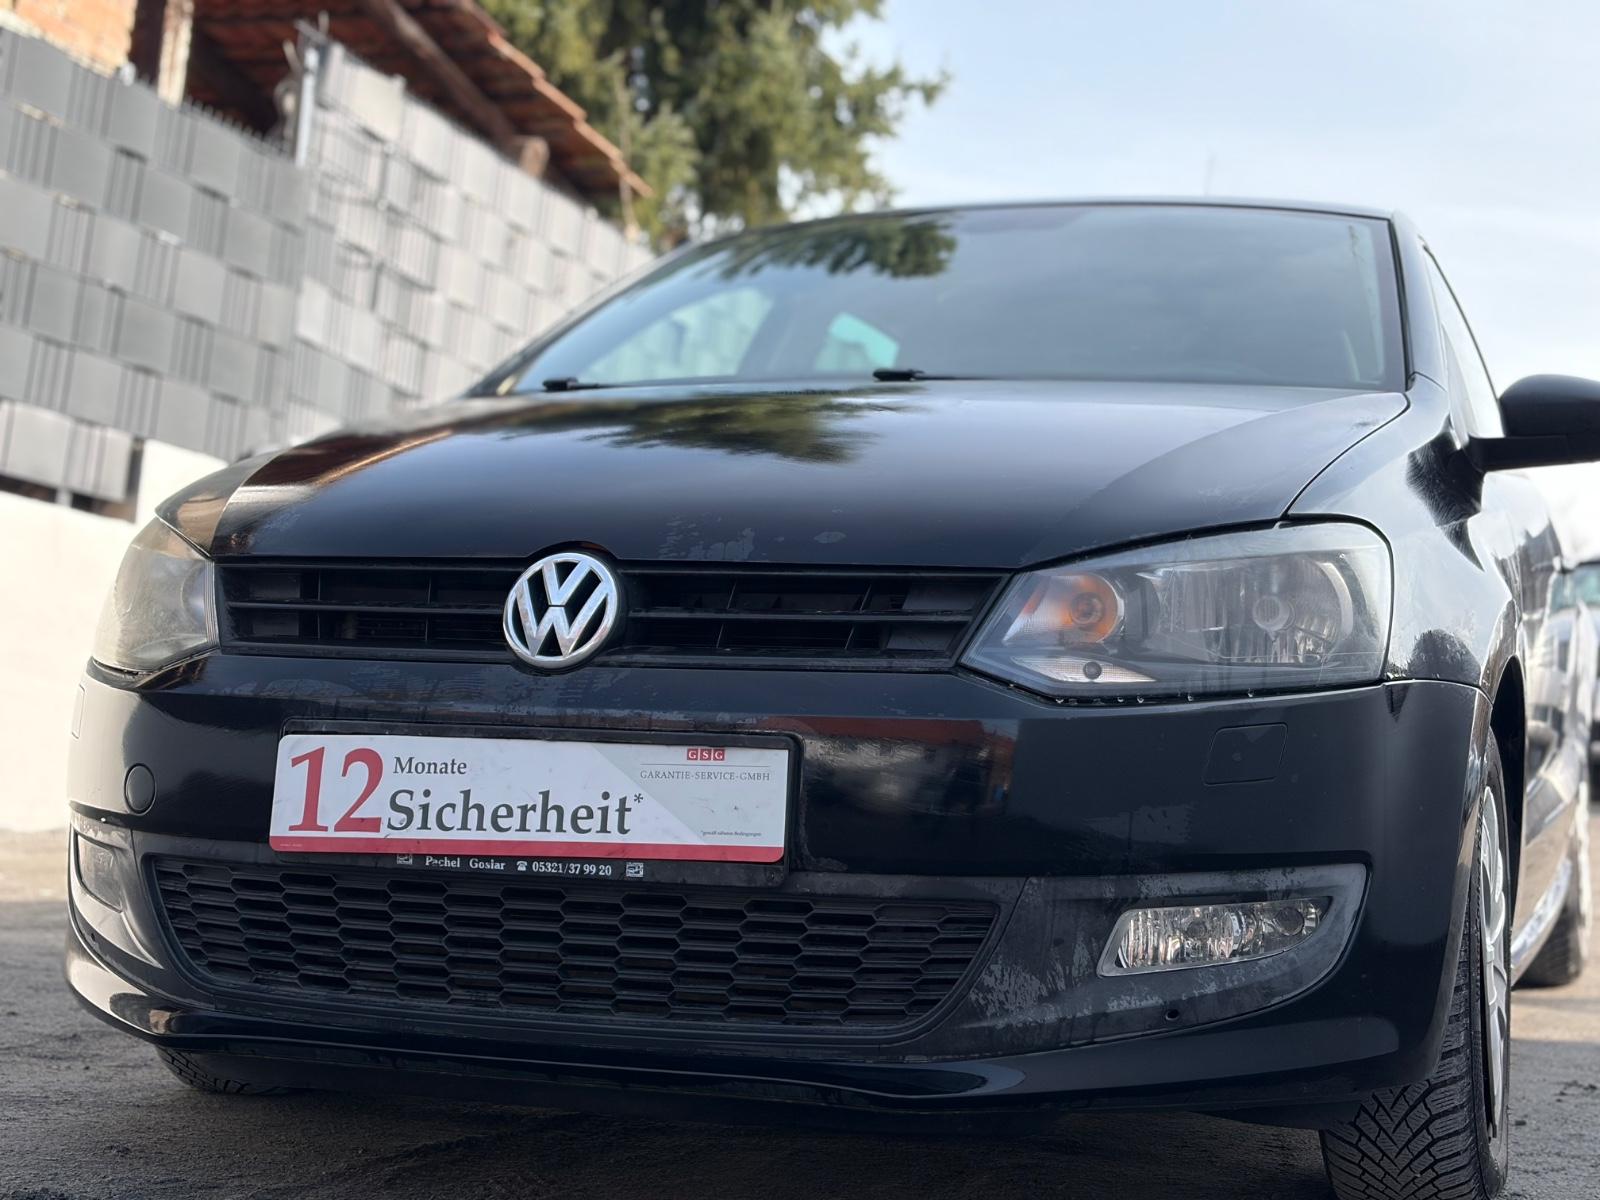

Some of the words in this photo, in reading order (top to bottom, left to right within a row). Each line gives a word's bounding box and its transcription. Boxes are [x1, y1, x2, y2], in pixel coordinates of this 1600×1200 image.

[508, 555, 613, 663] VW
[688, 749, 724, 760] GSG
[640, 770, 770, 781] GARANTIE-SERVICE-GMBH
[288, 746, 384, 833] 12
[393, 756, 467, 775] Monate
[583, 864, 597, 875] 99
[599, 865, 612, 876] 20
